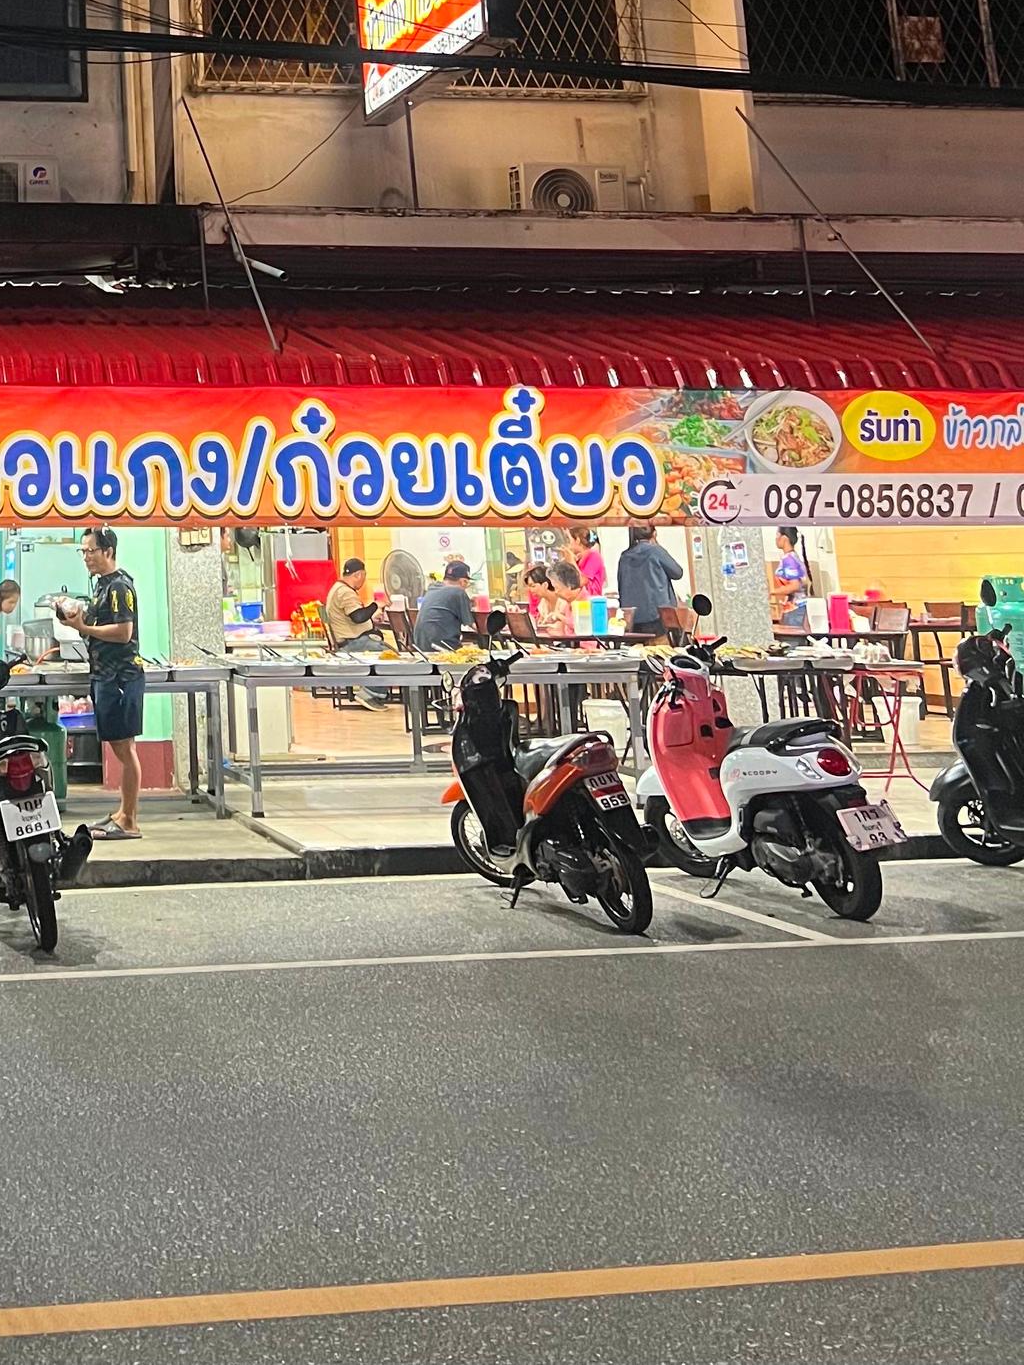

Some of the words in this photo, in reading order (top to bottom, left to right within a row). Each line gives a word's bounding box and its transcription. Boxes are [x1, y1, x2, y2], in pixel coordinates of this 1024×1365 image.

[859, 409, 922, 442] รับทำ
[708, 493, 728, 510] 24
[764, 483, 974, 518] 087-0856837
